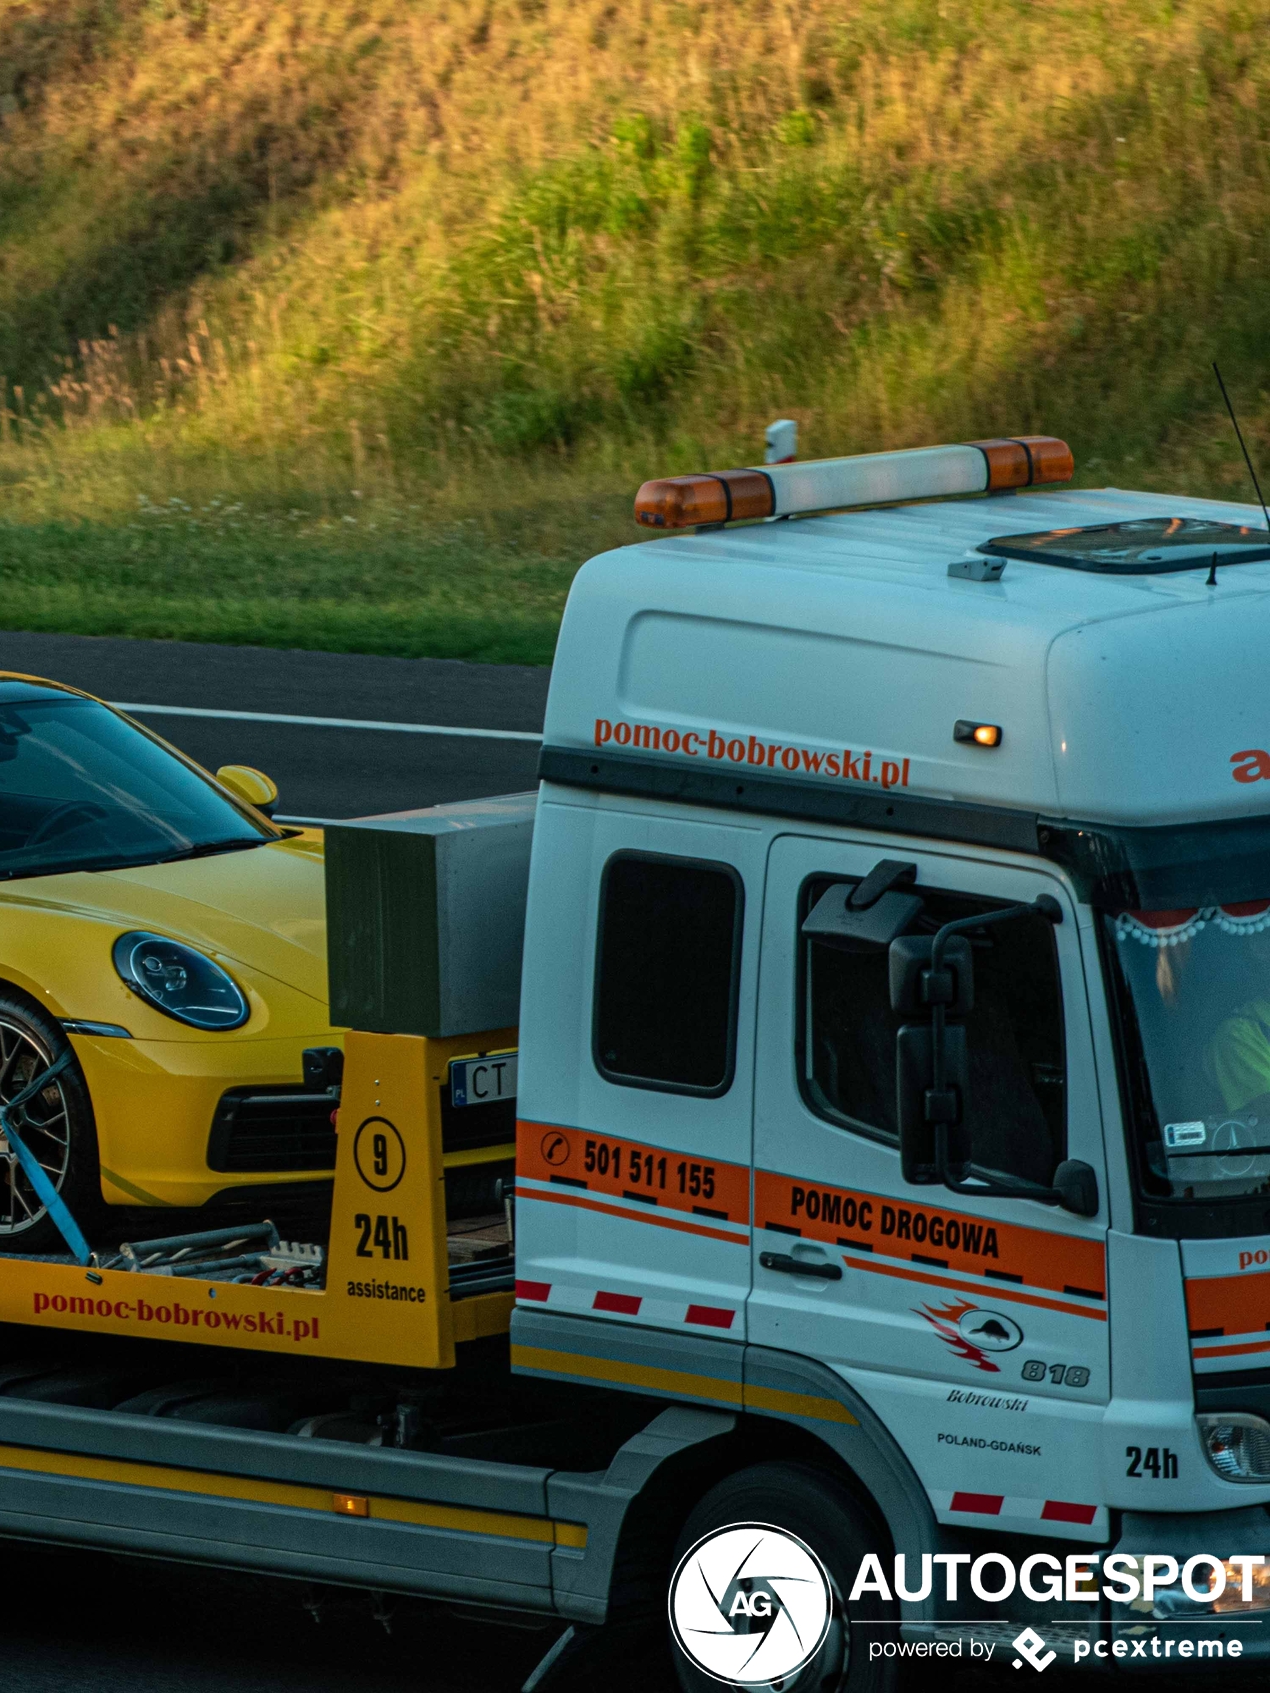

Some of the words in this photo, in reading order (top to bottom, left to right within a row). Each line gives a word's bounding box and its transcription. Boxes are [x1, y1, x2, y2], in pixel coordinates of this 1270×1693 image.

[594, 718, 910, 789] pomoc-bobrowski.pl
[455, 1089, 465, 1098] PL
[473, 1062, 507, 1098] CT
[373, 1133, 387, 1176] 9
[584, 1139, 621, 1178] 501
[629, 1150, 667, 1189] 511
[677, 1161, 715, 1199] 155
[354, 1213, 409, 1261] 24h
[791, 1186, 873, 1231] POMOC
[881, 1205, 999, 1259] DROGOWA
[347, 1278, 426, 1303] assistance
[33, 1291, 319, 1341] pomoc-bobrowski.pl
[1021, 1359, 1091, 1388] 818
[946, 1389, 1029, 1412] Bobrowski
[937, 1433, 1042, 1456] POLAND-GDAŃSK
[1126, 1446, 1179, 1479] 24h
